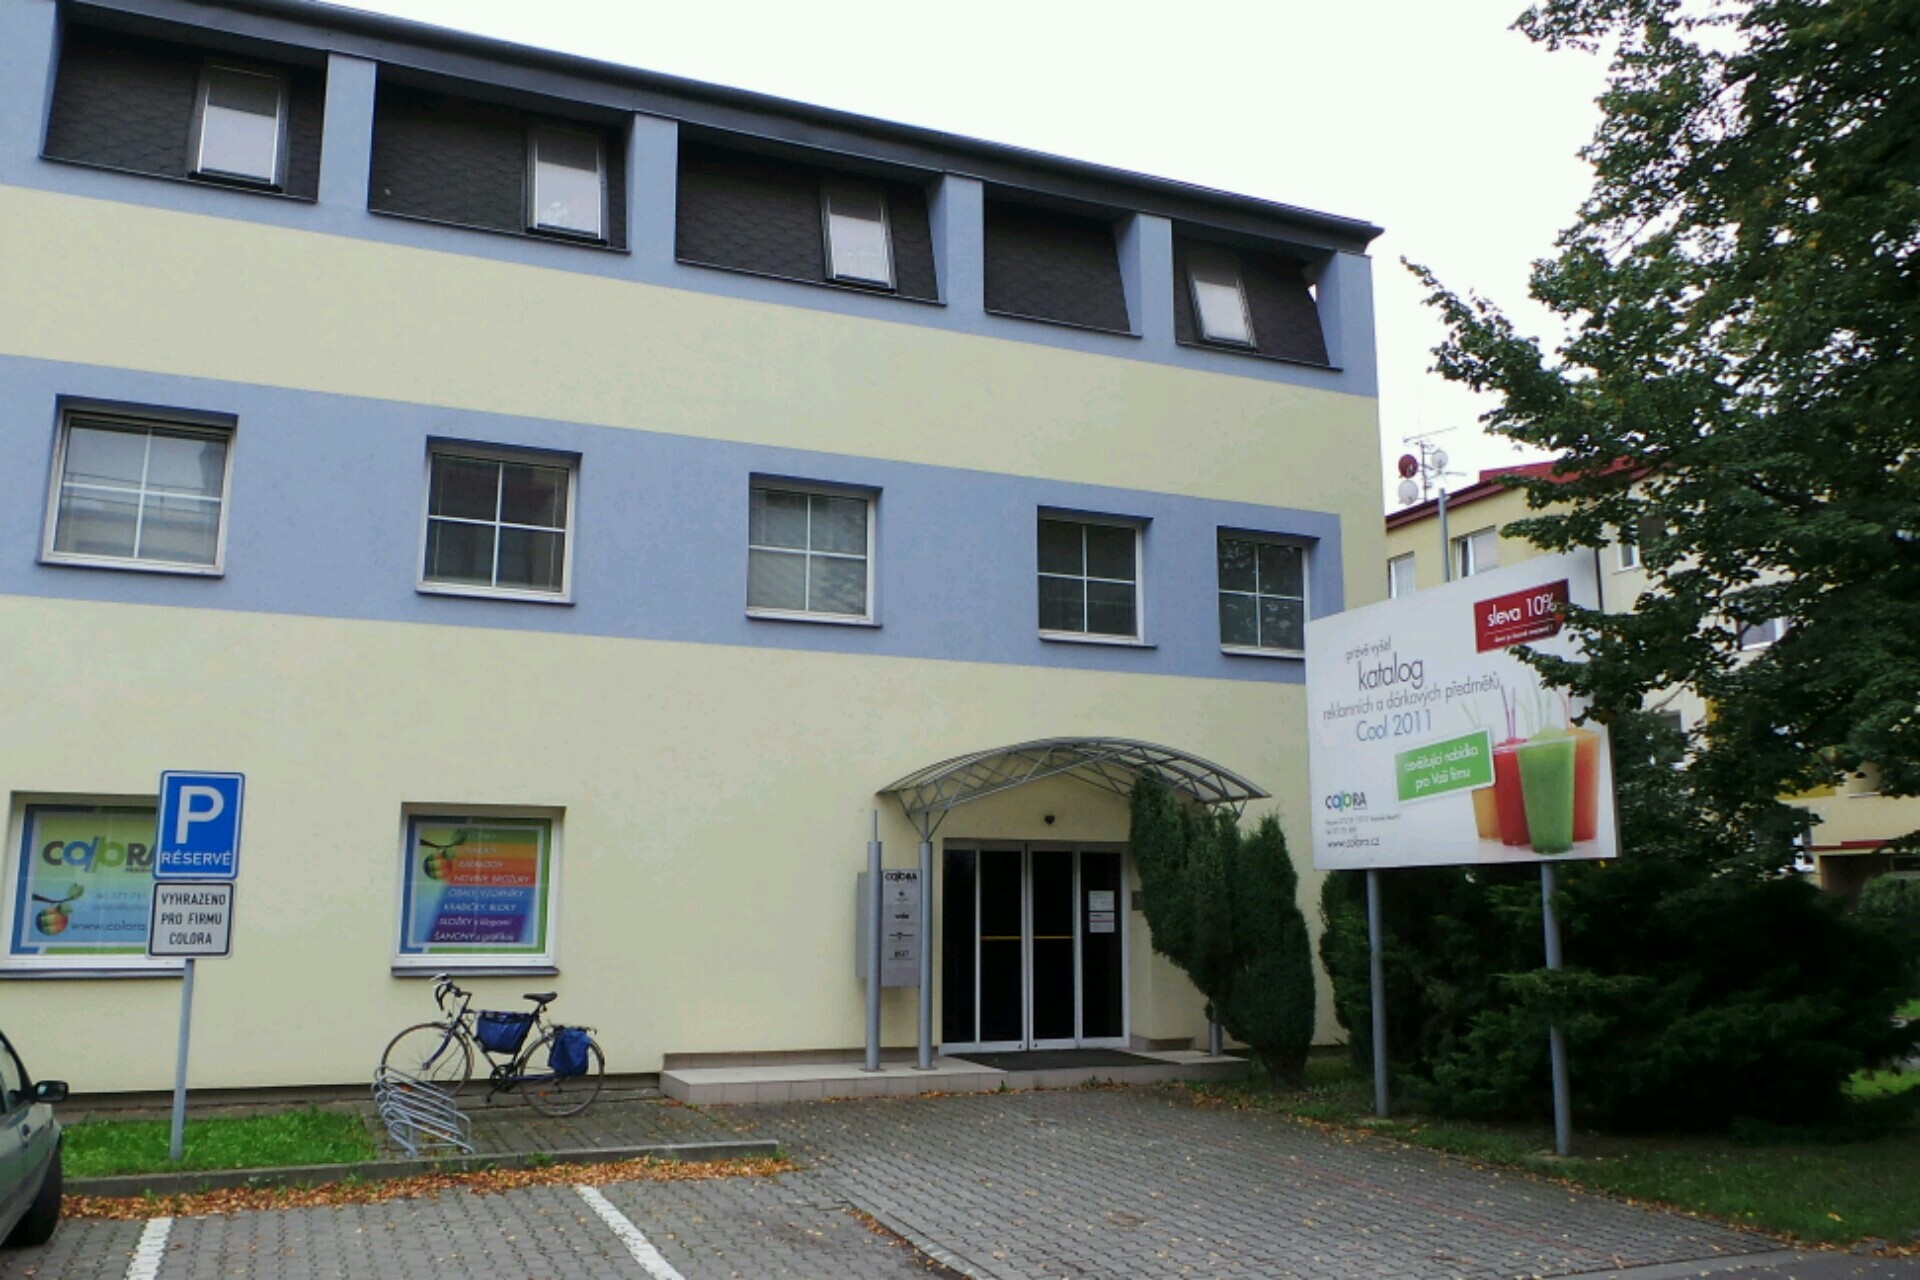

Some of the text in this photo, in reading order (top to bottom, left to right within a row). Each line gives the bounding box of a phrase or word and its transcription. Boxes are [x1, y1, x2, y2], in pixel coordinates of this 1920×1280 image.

[1487, 592, 1557, 627] sleva 10%
[1345, 635, 1392, 664] právě vyšel
[1358, 651, 1424, 691] katalog
[1323, 671, 1501, 721] reklamních a dárkových předmětů
[1356, 708, 1432, 742] Cool 2011
[1443, 742, 1478, 763] nabídka
[1415, 778, 1430, 793] pro
[175, 786, 225, 844] P
[160, 849, 232, 866] RÉSERVÉ
[161, 892, 226, 906] VYHRAZENO
[161, 912, 222, 925] PRO FIRMU
[169, 931, 212, 945] COLORA
